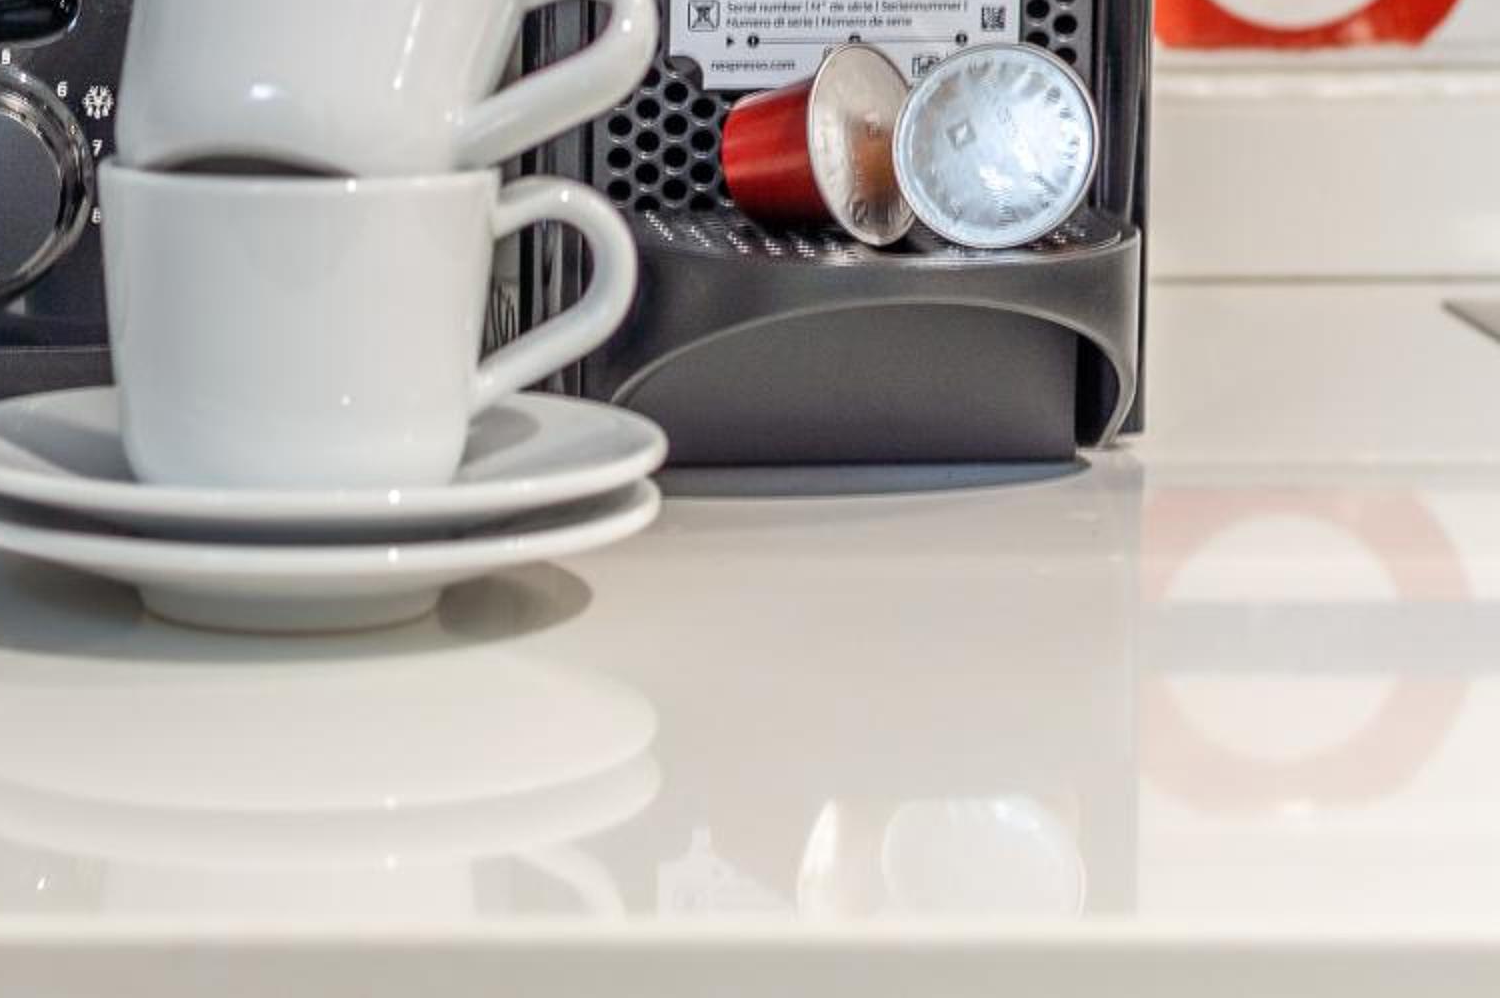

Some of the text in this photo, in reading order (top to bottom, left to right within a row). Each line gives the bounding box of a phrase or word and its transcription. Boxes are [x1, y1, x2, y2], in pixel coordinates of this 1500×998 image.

[759, 1, 801, 14] number
[710, 59, 796, 74] nespresso.com
[56, 81, 68, 97] 6
[92, 139, 103, 156] 7
